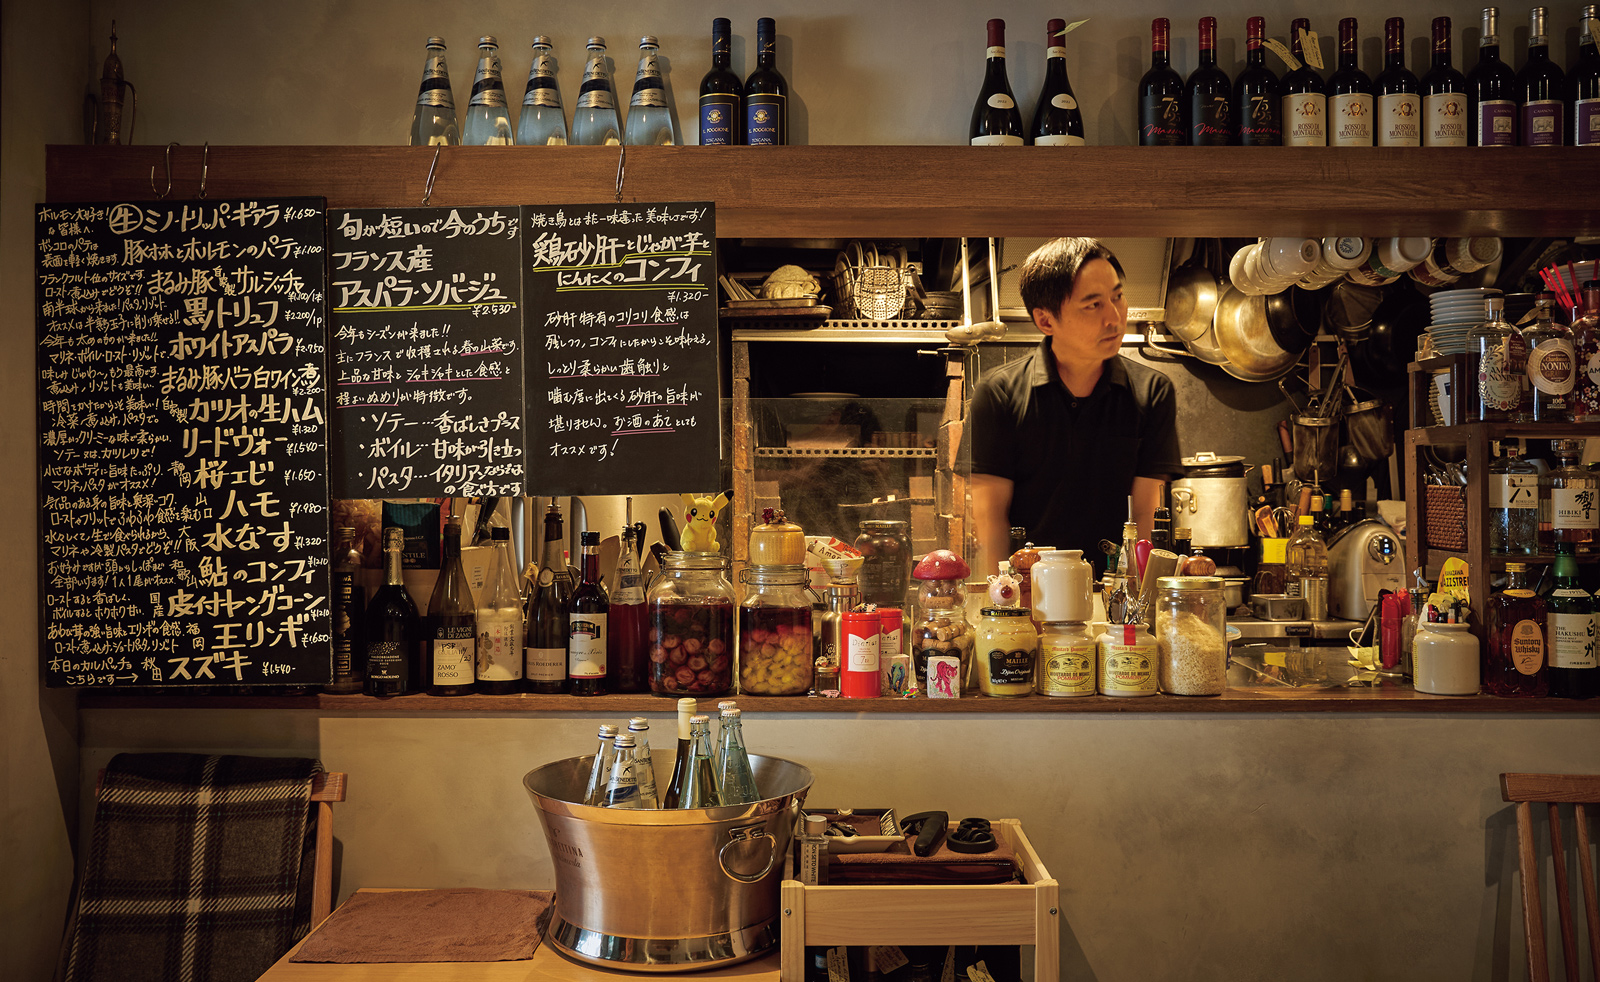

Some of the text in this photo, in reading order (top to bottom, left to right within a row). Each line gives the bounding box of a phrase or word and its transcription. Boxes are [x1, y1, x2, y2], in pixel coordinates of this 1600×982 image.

[336, 208, 519, 241] 旬が短いので今のうちです
[331, 243, 434, 273] フランス産
[532, 231, 710, 267] 鶏砂肝とじゃが芋と
[557, 257, 702, 286] にんにくのコンフィ
[183, 296, 279, 331] 黒トリュフ
[169, 328, 294, 360] ホワイトアスパラ
[547, 358, 670, 377] しっとり柔らかい歯触りと
[1541, 361, 1571, 370] NONINO
[182, 425, 289, 457] リードヴォー
[218, 489, 281, 520] ハモ
[1575, 490, 1597, 519] 響
[201, 521, 296, 553] 水なす
[198, 556, 316, 588] 鮎のコンフィ
[167, 584, 326, 618] 皮付ヤングコーン
[1514, 638, 1541, 646] Suntory
[1515, 646, 1540, 655] Whisky
[47, 656, 133, 673] 本日のカルパッチョ
[167, 651, 253, 681] スズキ
